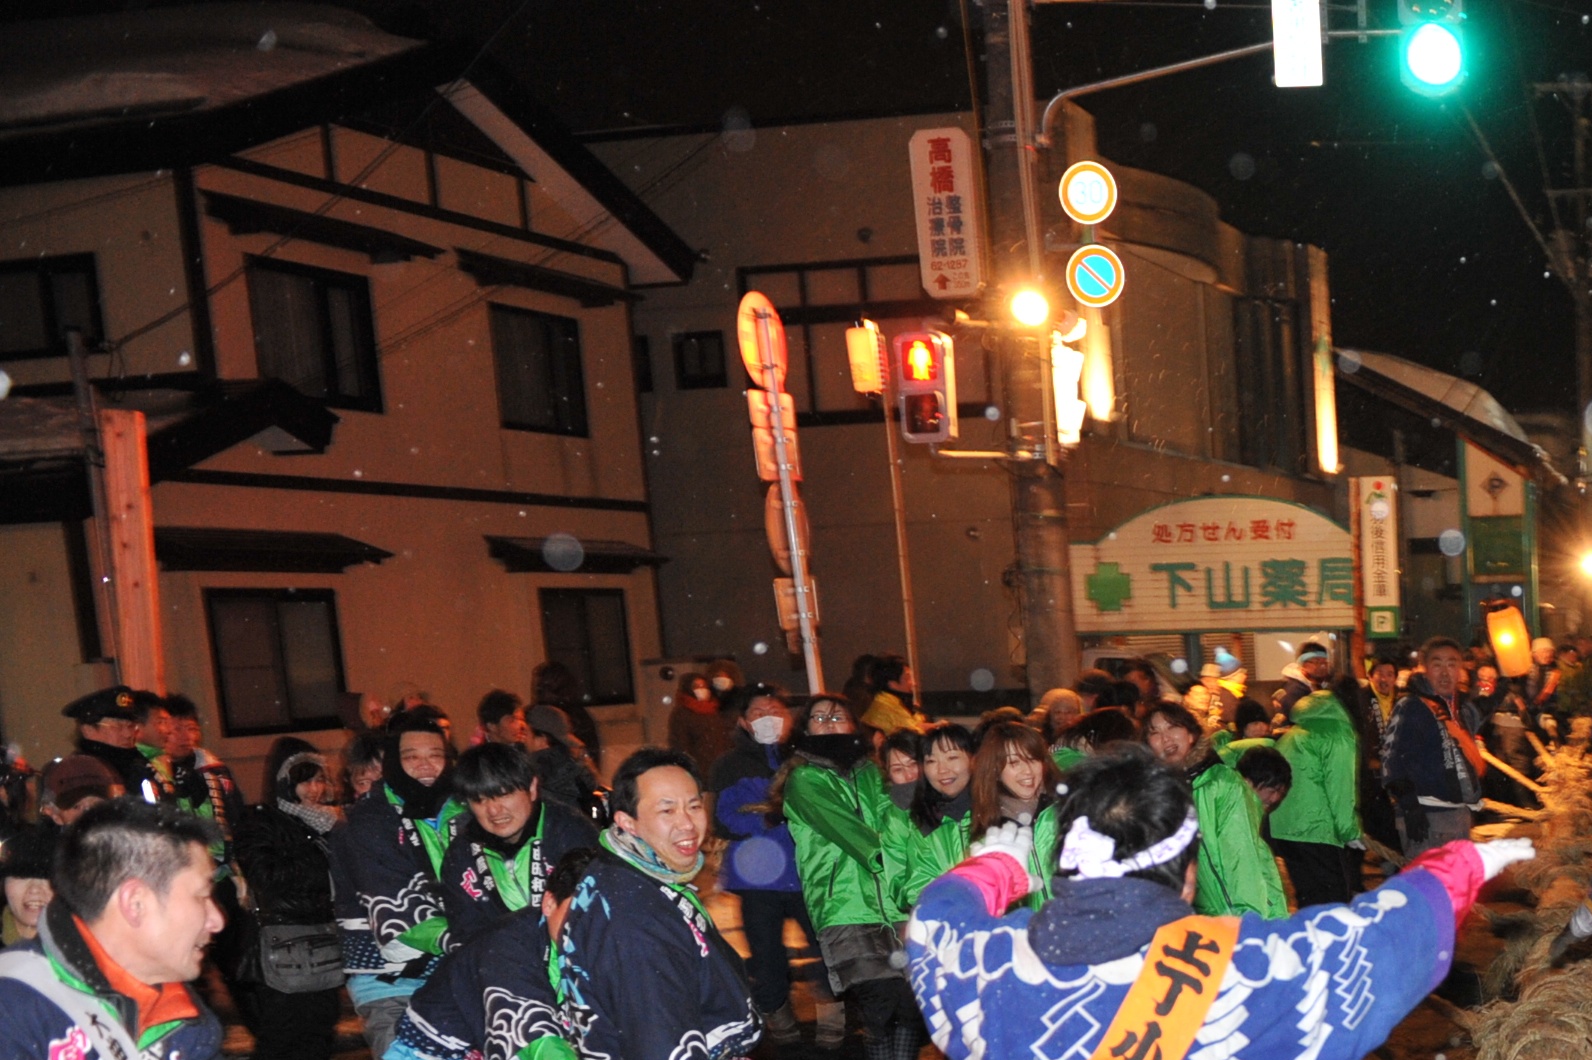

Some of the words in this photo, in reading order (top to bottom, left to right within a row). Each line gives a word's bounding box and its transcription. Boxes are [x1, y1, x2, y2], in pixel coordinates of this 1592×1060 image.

[927, 137, 955, 194] 高橋
[1074, 180, 1103, 204] 30
[926, 196, 948, 258] 治療院
[946, 194, 966, 256] 整骨院
[1152, 518, 1296, 544] 処方せん受付
[1150, 556, 1354, 609] 下山薬局
